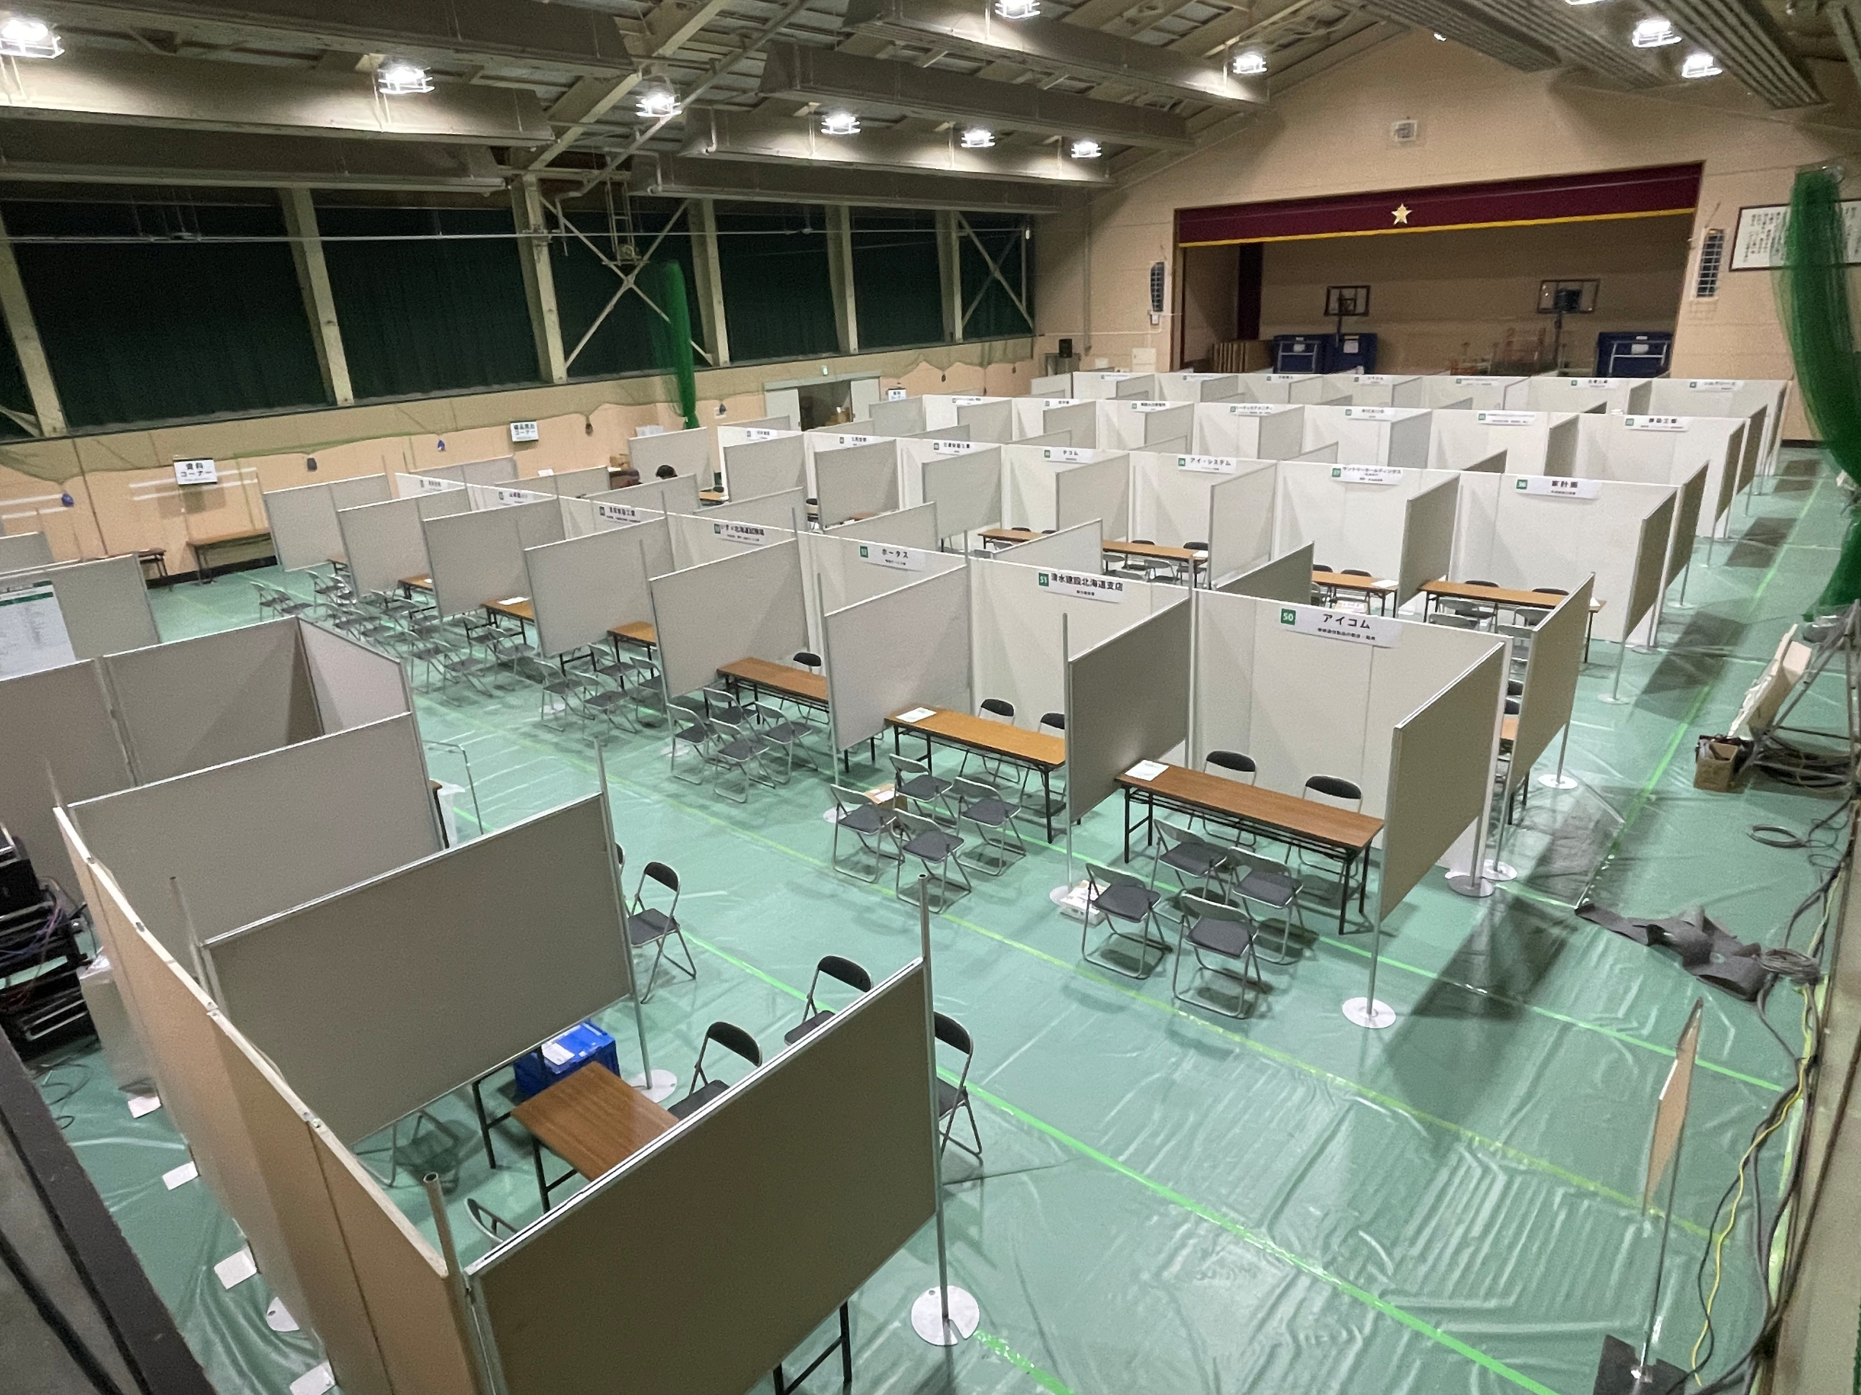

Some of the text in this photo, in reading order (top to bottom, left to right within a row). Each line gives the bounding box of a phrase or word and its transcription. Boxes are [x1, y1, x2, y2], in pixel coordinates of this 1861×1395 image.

[1190, 457, 1232, 466] アイ・システム
[180, 470, 213, 478] コーナー
[1342, 466, 1402, 475] サントリーホールディングス
[1039, 572, 1124, 592] 51 清水建設北海道支店
[1282, 612, 1371, 630] 50 アイコム
